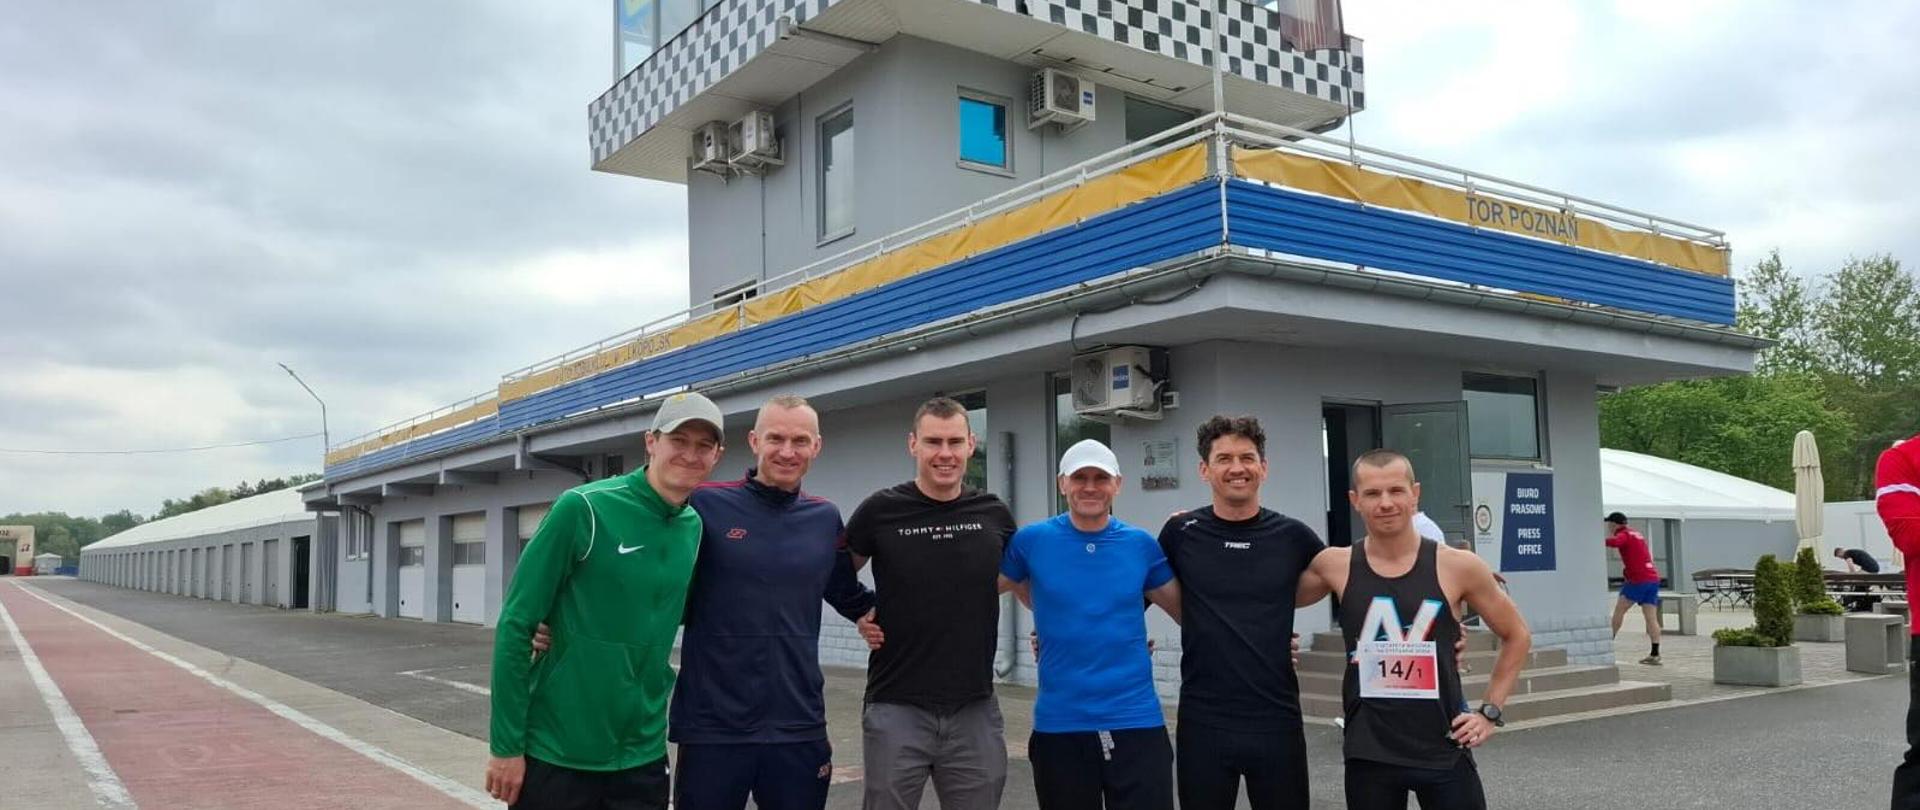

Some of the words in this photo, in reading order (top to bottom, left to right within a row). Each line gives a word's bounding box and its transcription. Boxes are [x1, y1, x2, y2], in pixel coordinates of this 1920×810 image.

[1466, 197, 1505, 225] TOR
[1517, 488, 1539, 498] BIURO
[1510, 504, 1546, 514] PRASOWE
[898, 526, 933, 536] TOMMY
[945, 523, 983, 531] HILFIGER
[1518, 528, 1541, 539] PRESS
[1518, 545, 1542, 555] OFFICE
